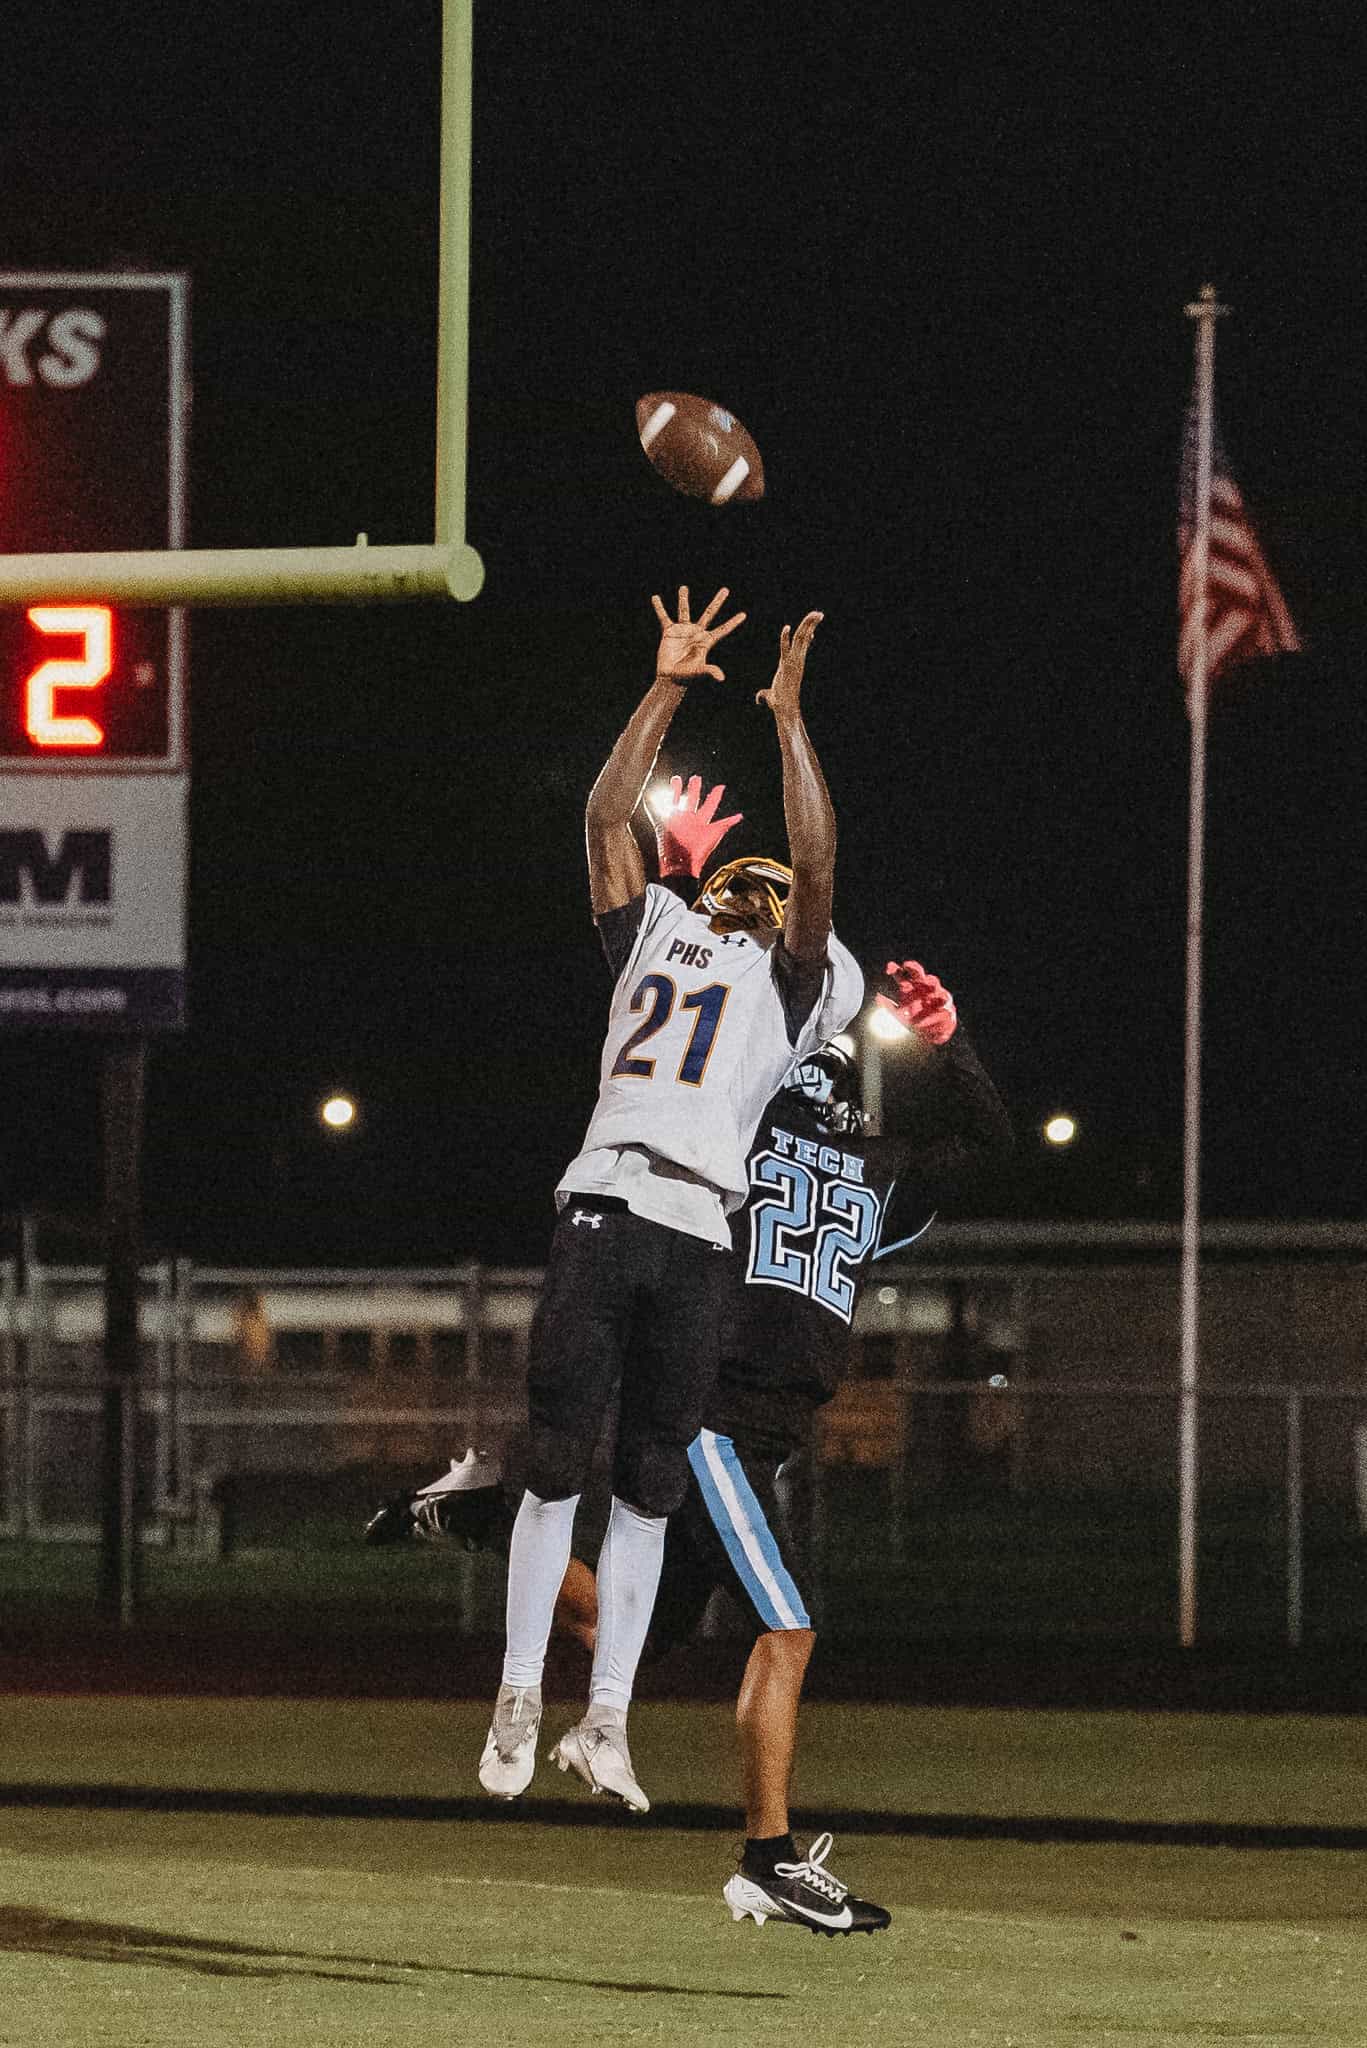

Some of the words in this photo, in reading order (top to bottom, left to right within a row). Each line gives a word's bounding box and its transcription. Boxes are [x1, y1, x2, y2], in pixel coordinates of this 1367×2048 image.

[27, 607, 112, 744] 2
[665, 937, 713, 969] PHS
[611, 972, 732, 1088] 21
[771, 1127, 865, 1182] TECH
[745, 1150, 879, 1325] 22
